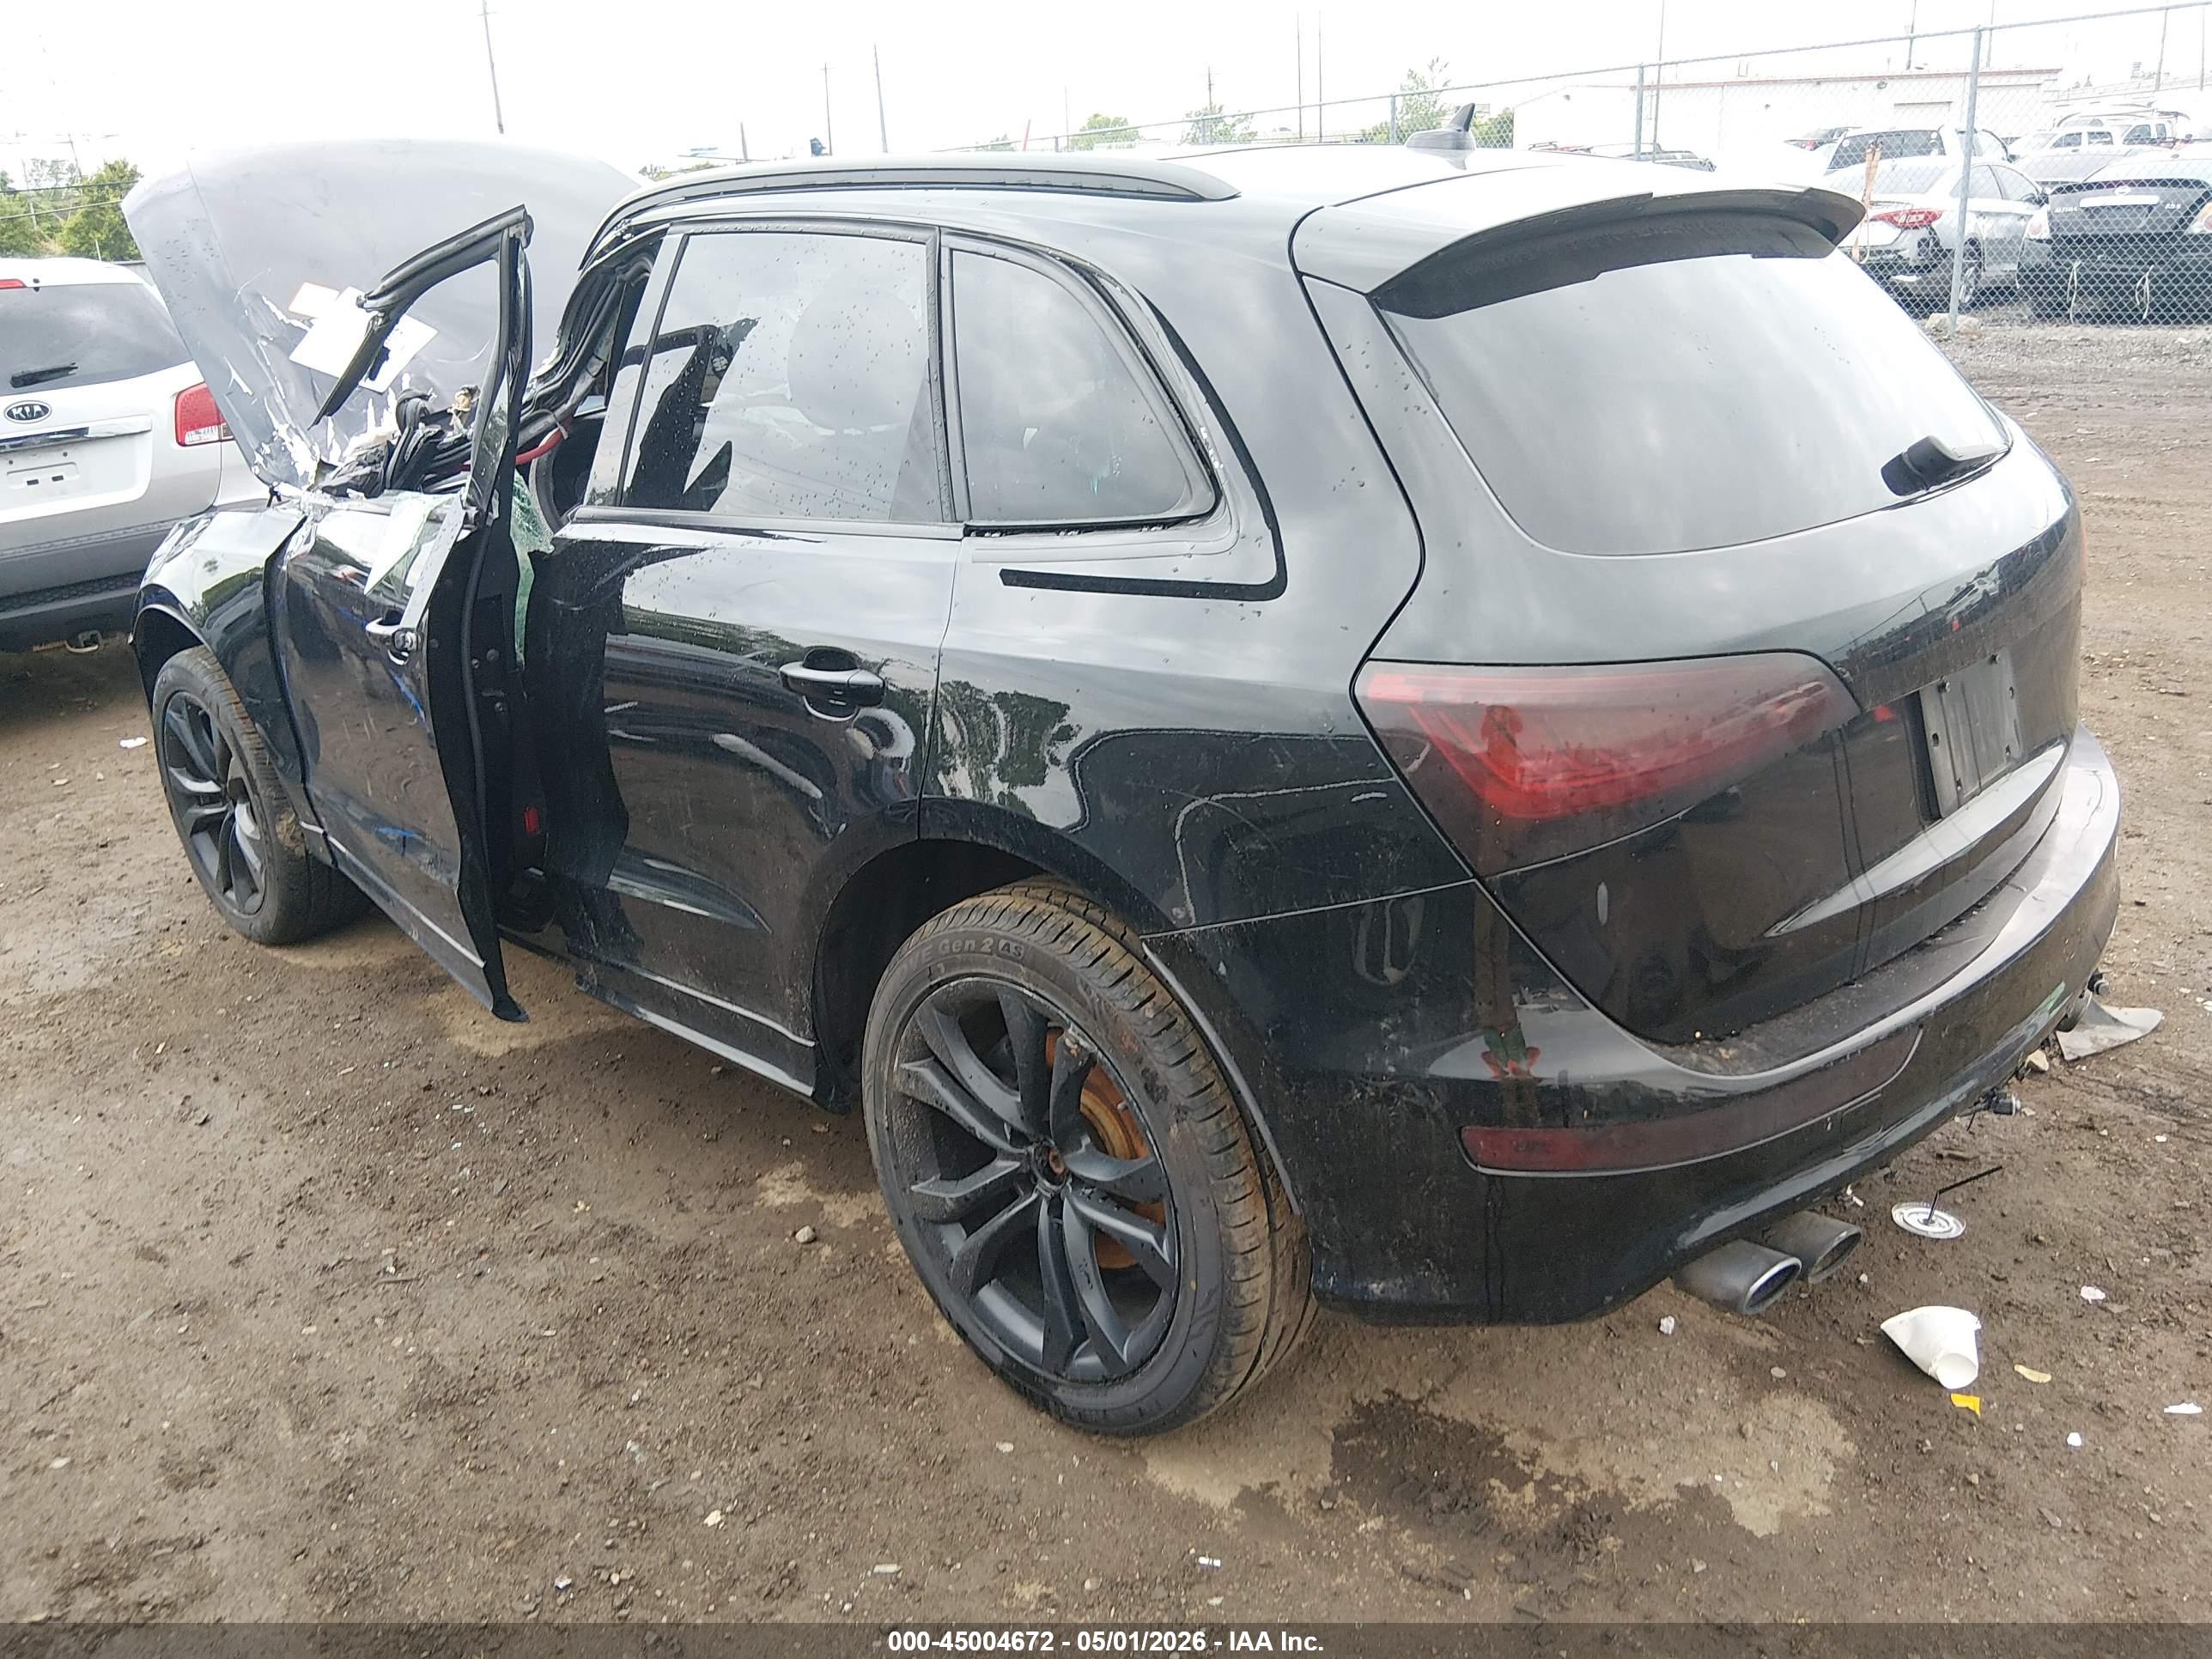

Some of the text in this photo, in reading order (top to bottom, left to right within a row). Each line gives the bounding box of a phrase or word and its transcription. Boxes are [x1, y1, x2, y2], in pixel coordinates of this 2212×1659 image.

[11, 404, 46, 419] KIA
[938, 936, 1024, 960] Gen 2 AS
